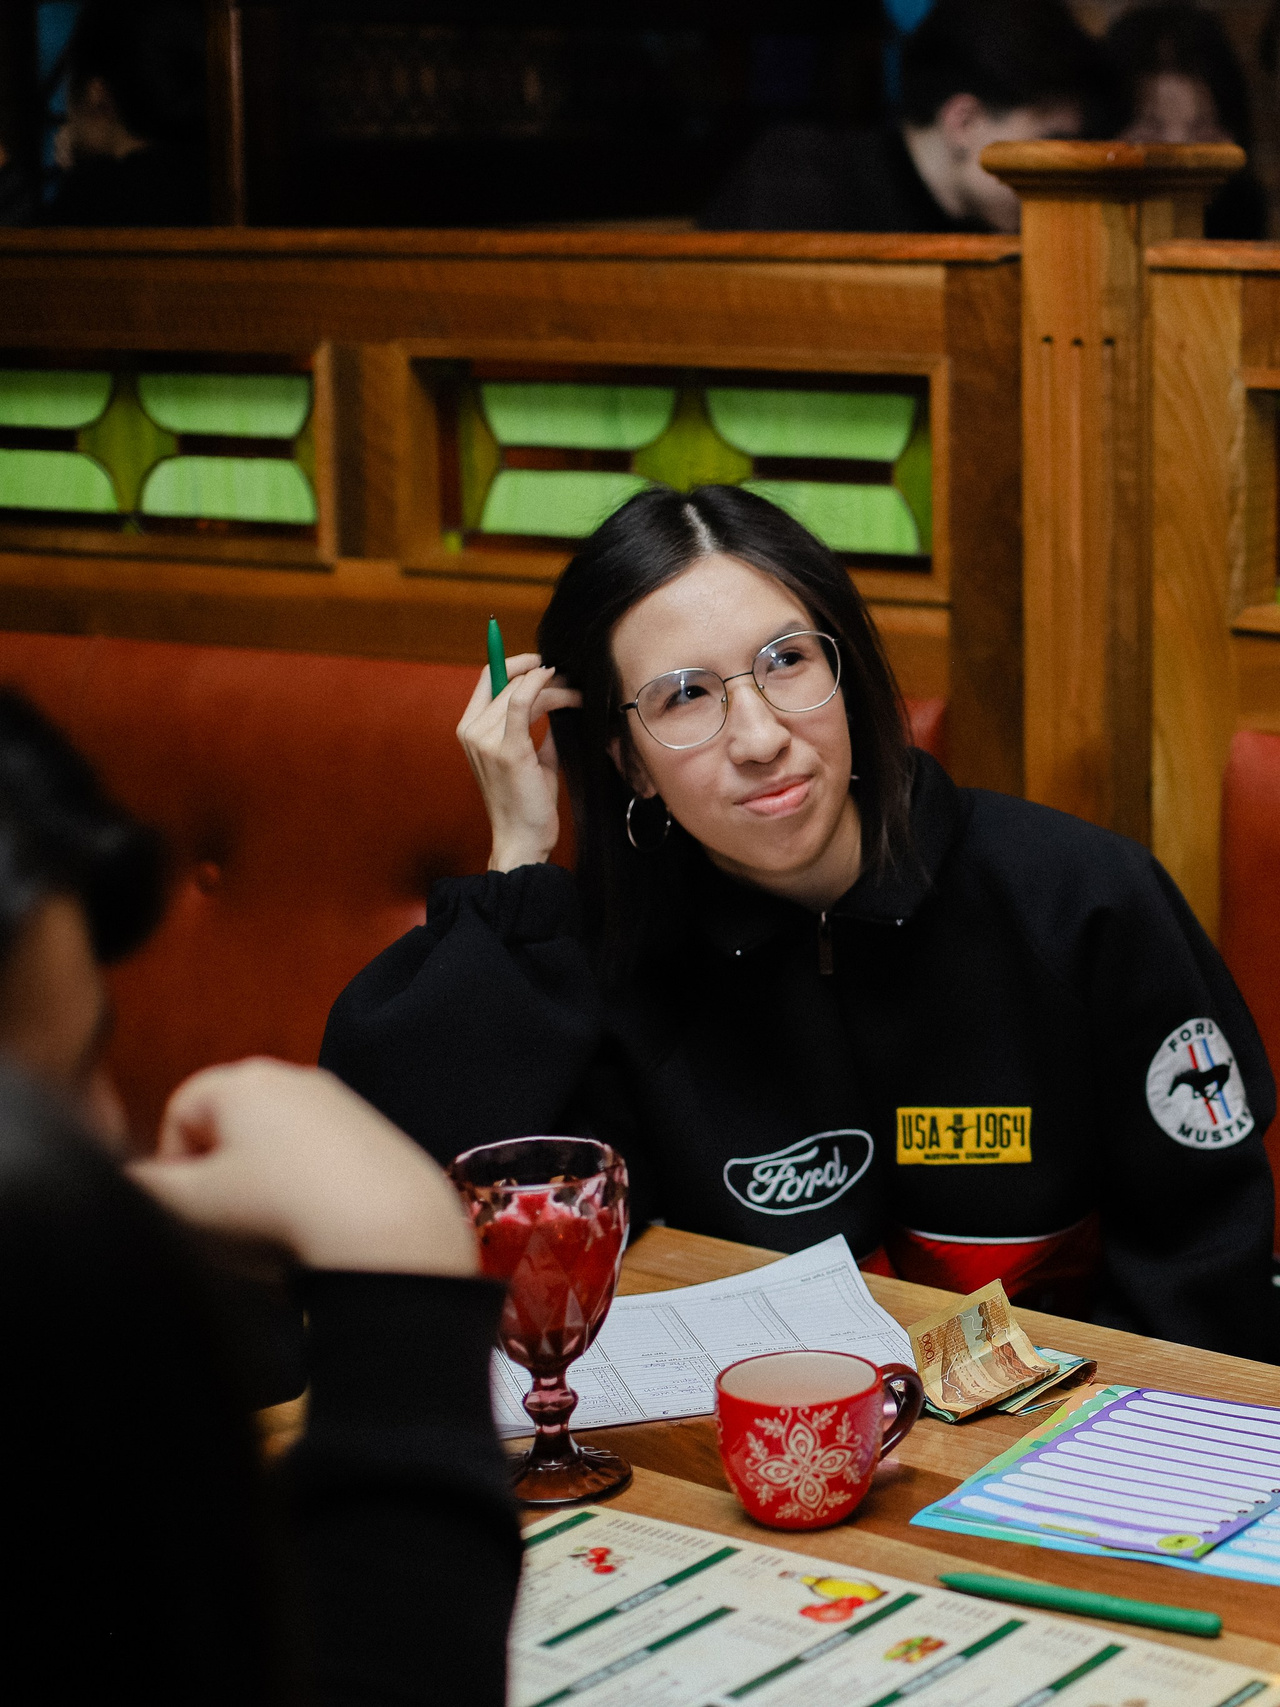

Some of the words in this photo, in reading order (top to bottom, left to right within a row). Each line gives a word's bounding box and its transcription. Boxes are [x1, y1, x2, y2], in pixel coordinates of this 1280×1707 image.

[901, 1113, 941, 1149] USA
[976, 1113, 1025, 1149] 1964
[747, 1146, 849, 1203] Ford
